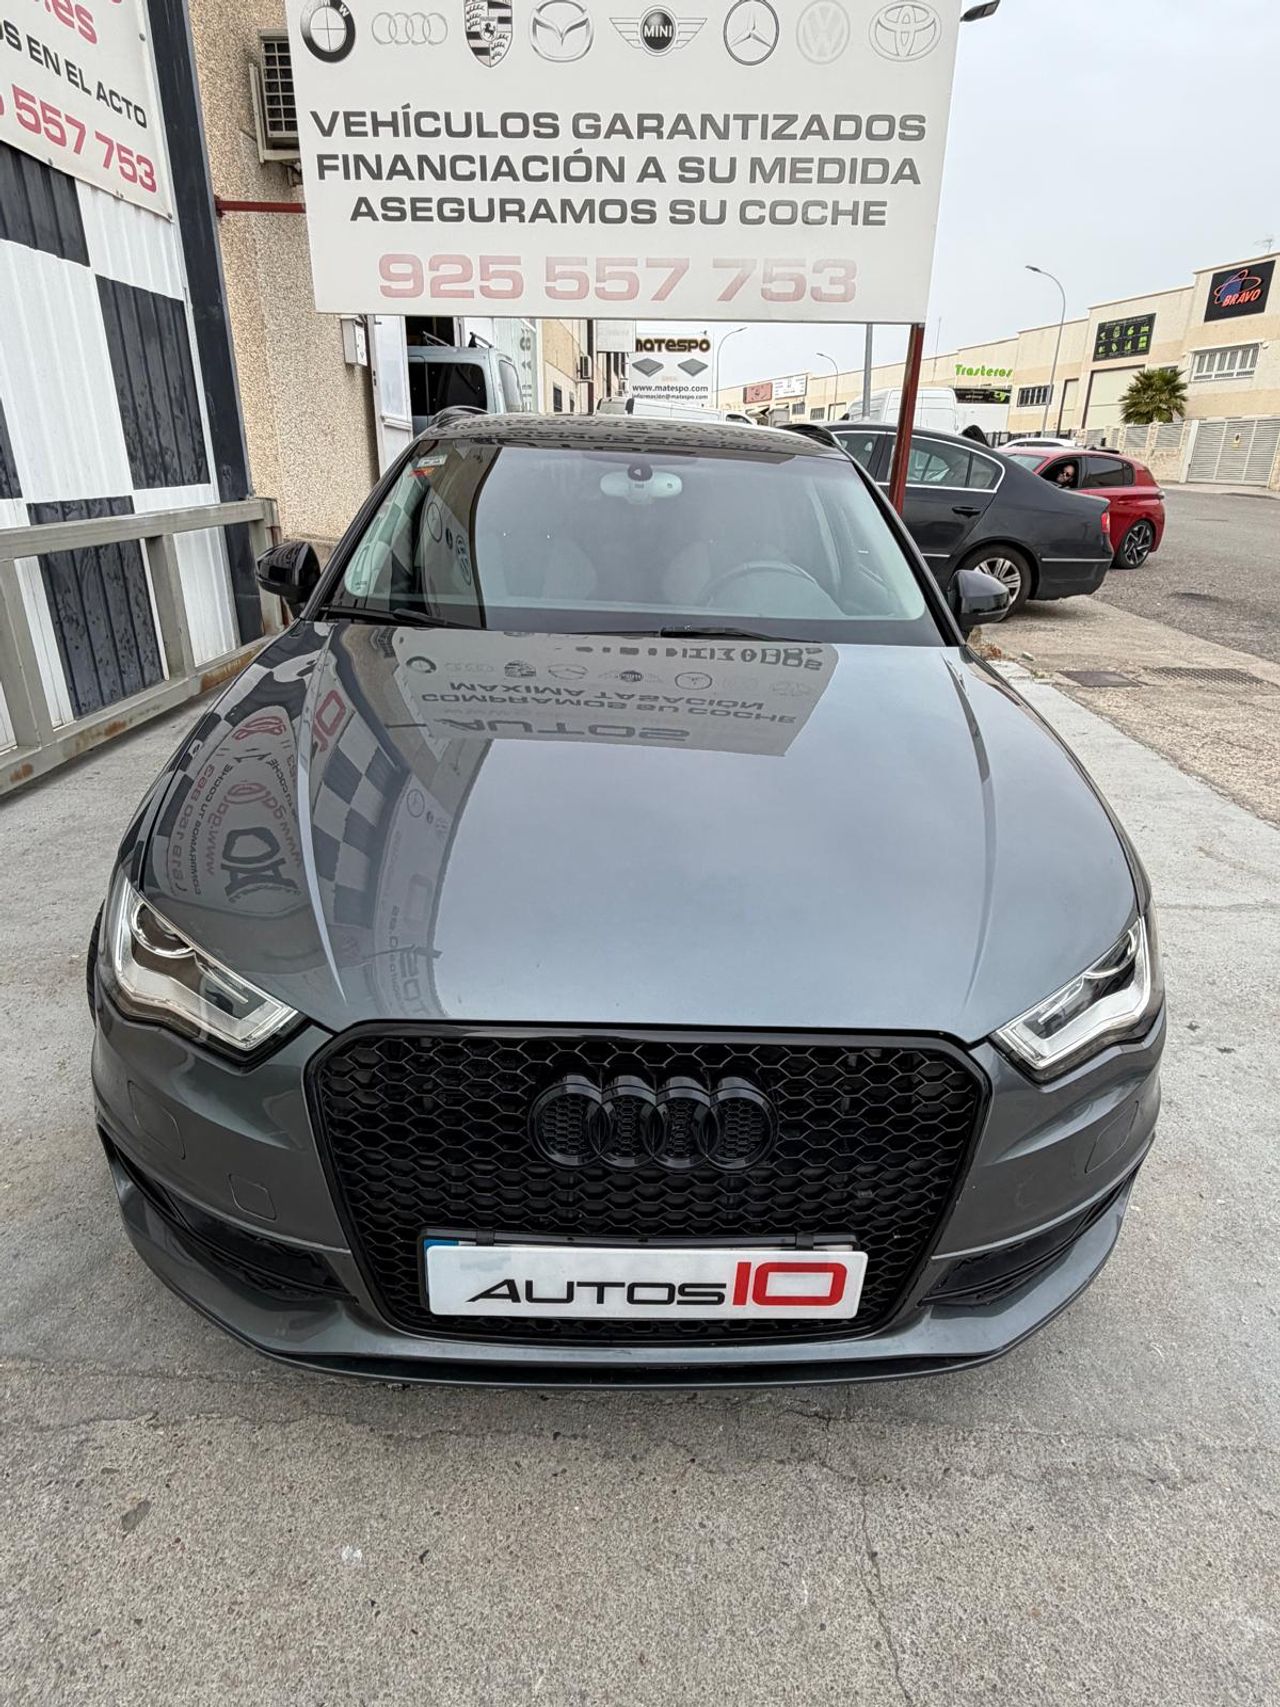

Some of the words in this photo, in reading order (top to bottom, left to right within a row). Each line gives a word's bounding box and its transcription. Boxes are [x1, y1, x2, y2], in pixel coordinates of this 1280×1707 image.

[644, 24, 673, 39] MINI
[0, 20, 22, 51] S
[26, 34, 61, 77] EN
[64, 58, 92, 96] EL
[96, 81, 147, 128] ACTO
[12, 83, 86, 155] 557
[95, 130, 157, 193] 753
[310, 103, 560, 139] VEHÍCULOS
[571, 112, 927, 141] GARANTIZADOS
[316, 148, 625, 183] FINANCIACIÓN
[636, 157, 667, 184] A
[677, 157, 737, 184] SU
[749, 157, 921, 185] MEDIDA
[350, 196, 657, 225] ASEGURAMOS
[668, 199, 728, 226] SU
[739, 200, 887, 226] COCHE
[378, 254, 524, 299] 925
[544, 257, 690, 301] 557
[711, 257, 858, 302] 753
[1221, 288, 1261, 308] BRAVO
[954, 364, 1013, 378] Trasteros
[632, 384, 709, 394] www.matespo.com
